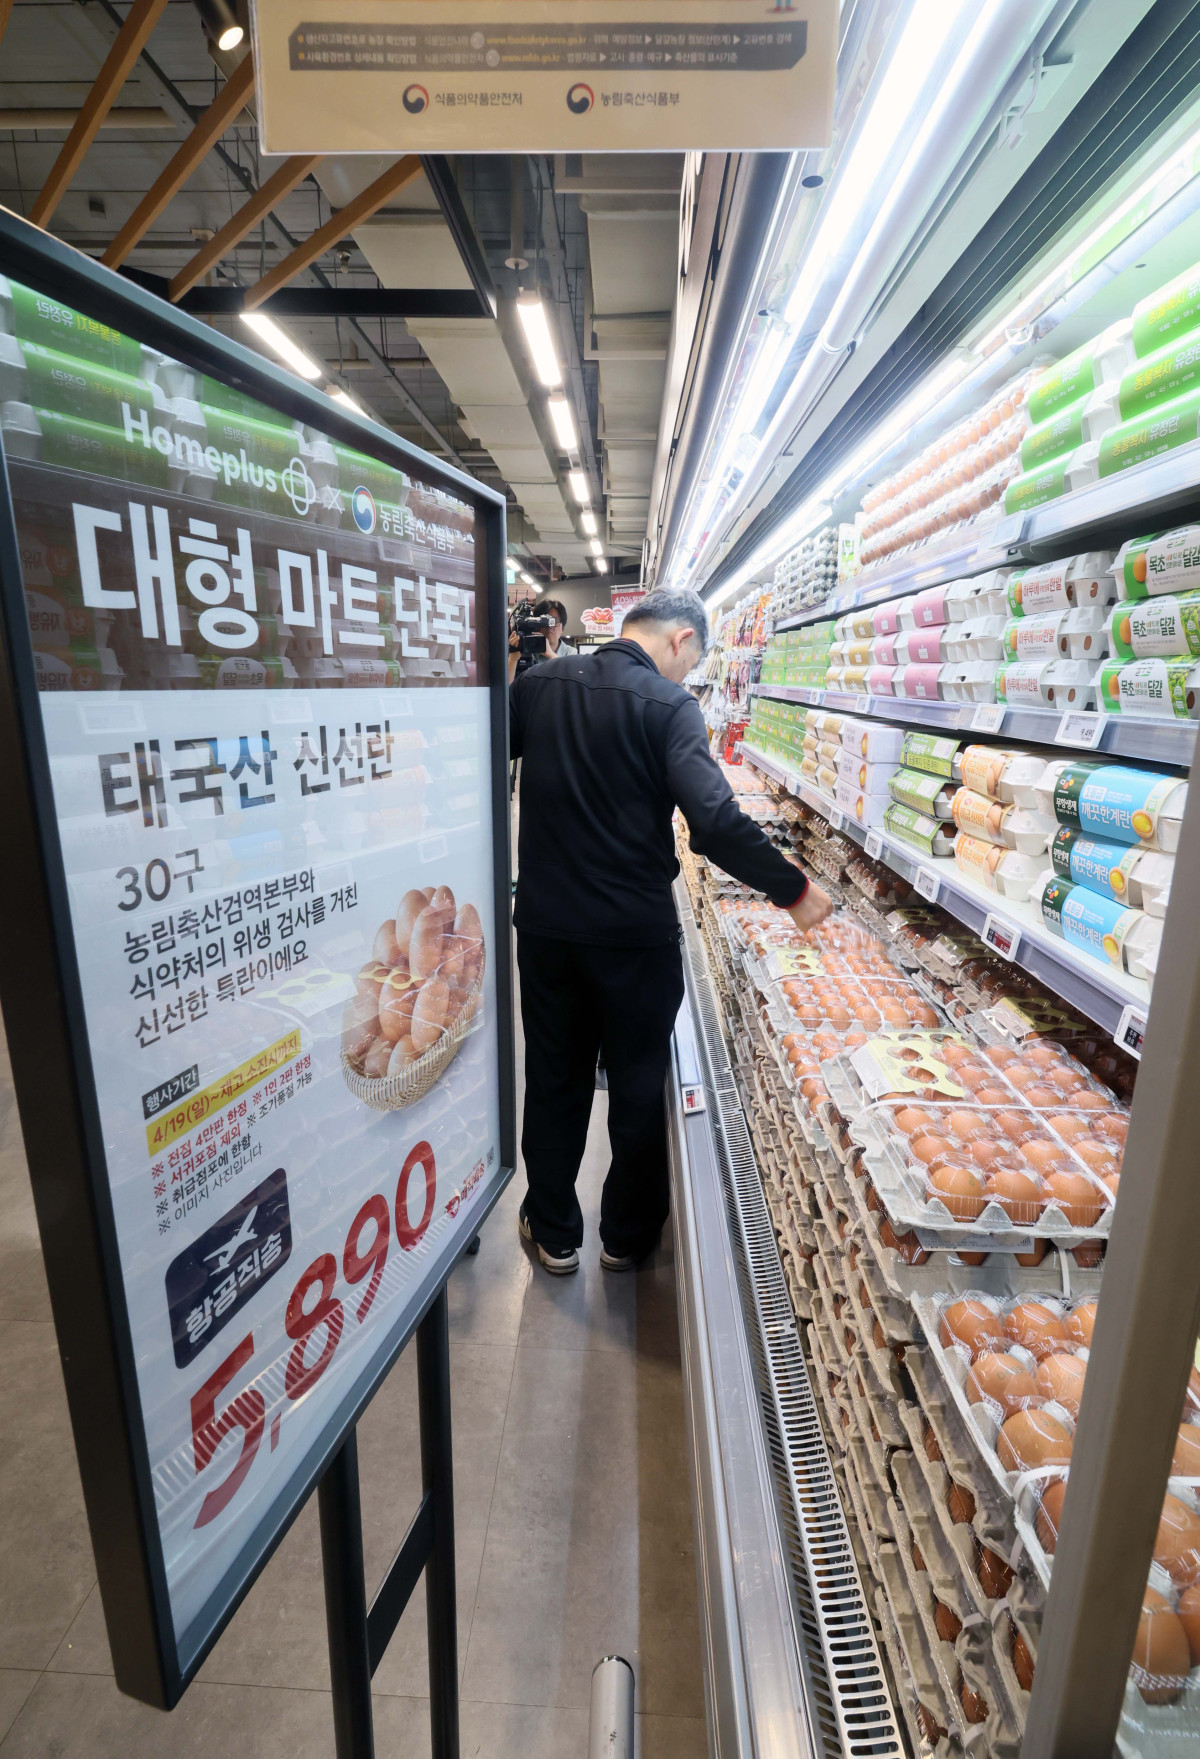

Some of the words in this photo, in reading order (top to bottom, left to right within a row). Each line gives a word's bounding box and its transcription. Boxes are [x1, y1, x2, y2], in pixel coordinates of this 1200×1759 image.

[435, 92, 523, 107] 식품의약품안전처
[600, 92, 680, 107] 농림축산식품부
[1134, 358, 1173, 391] 동물복지
[121, 401, 278, 493] Homeplus
[1112, 427, 1148, 457] 동물복지
[1149, 414, 1180, 441] 유정란
[379, 504, 455, 553] 농림축산식품부
[72, 502, 259, 649] 대형
[277, 548, 386, 655] 마트
[394, 575, 471, 663] 단독!
[1149, 553, 1166, 574] 목초
[1132, 620, 1147, 638] 목초
[1160, 616, 1176, 636] 달걀
[1121, 680, 1135, 697] 목초
[1148, 680, 1163, 698] 달걀
[98, 730, 278, 829] 태국산
[292, 720, 395, 796] 신선란
[1056, 797, 1078, 812] 무항생제
[1081, 802, 1131, 829] 깨끗한계란
[117, 847, 205, 912] 30구
[1071, 855, 1109, 885] 깨끗한계란
[123, 867, 316, 965] 농림축산검역본부와
[129, 937, 227, 1001] 식약처의
[233, 918, 271, 959] 위생
[277, 897, 326, 940] 검사를
[330, 882, 358, 913] 거친
[1063, 915, 1102, 949] 깨끗한계란
[134, 985, 209, 1049] 신선한
[215, 939, 309, 1002] 특란이에요
[145, 1069, 198, 1113] 행사기간
[167, 1140, 193, 1168] 전점
[195, 1116, 224, 1146] 4만판
[227, 1100, 248, 1125] 한정
[263, 1081, 278, 1096] 1인
[279, 1067, 293, 1086] 2판
[295, 1054, 312, 1075] 한정
[170, 1143, 217, 1185] 서귀포점
[220, 1123, 241, 1147] 제외
[259, 1085, 294, 1119] 조기품절
[296, 1072, 313, 1090] 가능
[172, 1155, 229, 1204] 취급점포에
[231, 1133, 252, 1159] 한함
[175, 1186, 209, 1220] 이미지
[213, 1142, 263, 1190] 사진입니다
[185, 1232, 282, 1344] 항공직송
[191, 1140, 437, 1530] 5,890
